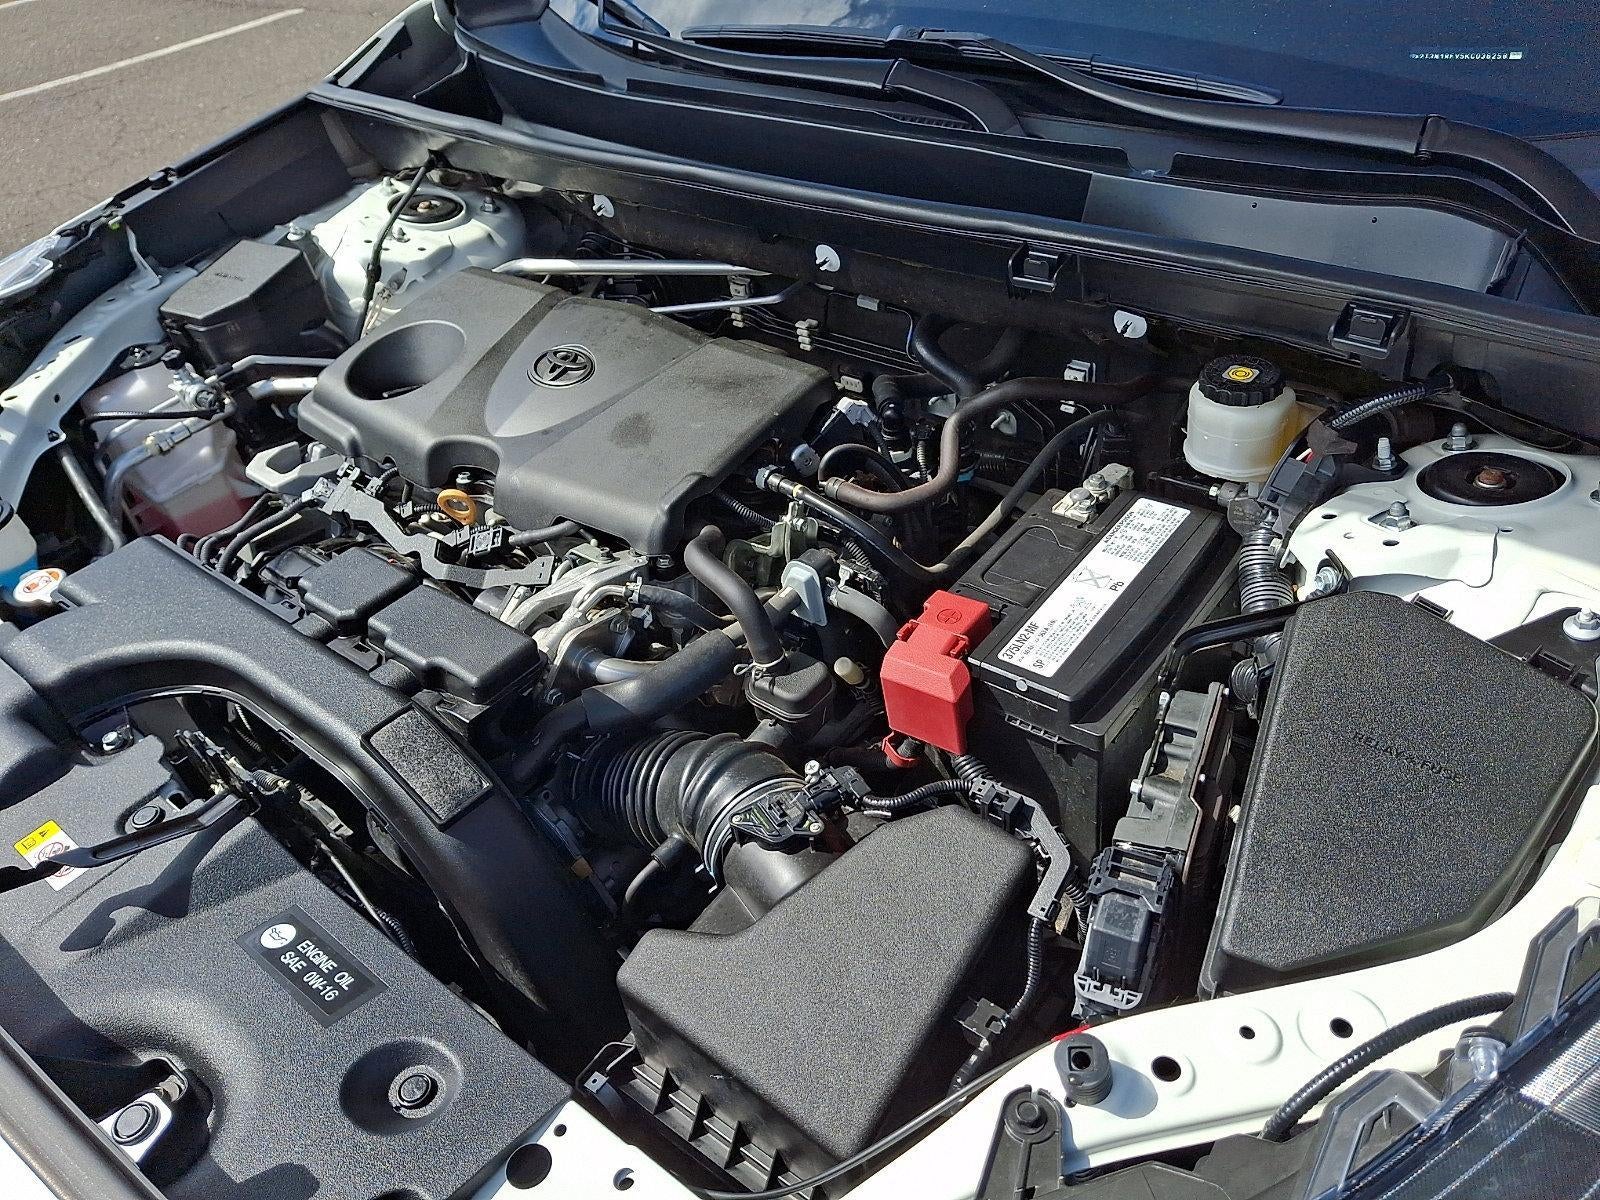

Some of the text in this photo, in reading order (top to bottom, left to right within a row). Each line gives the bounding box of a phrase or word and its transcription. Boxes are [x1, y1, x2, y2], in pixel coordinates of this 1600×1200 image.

[1109, 581, 1124, 591] Pb
[280, 951, 339, 1001] SAE 0W-16
[296, 940, 355, 991] ENGINE OIL
